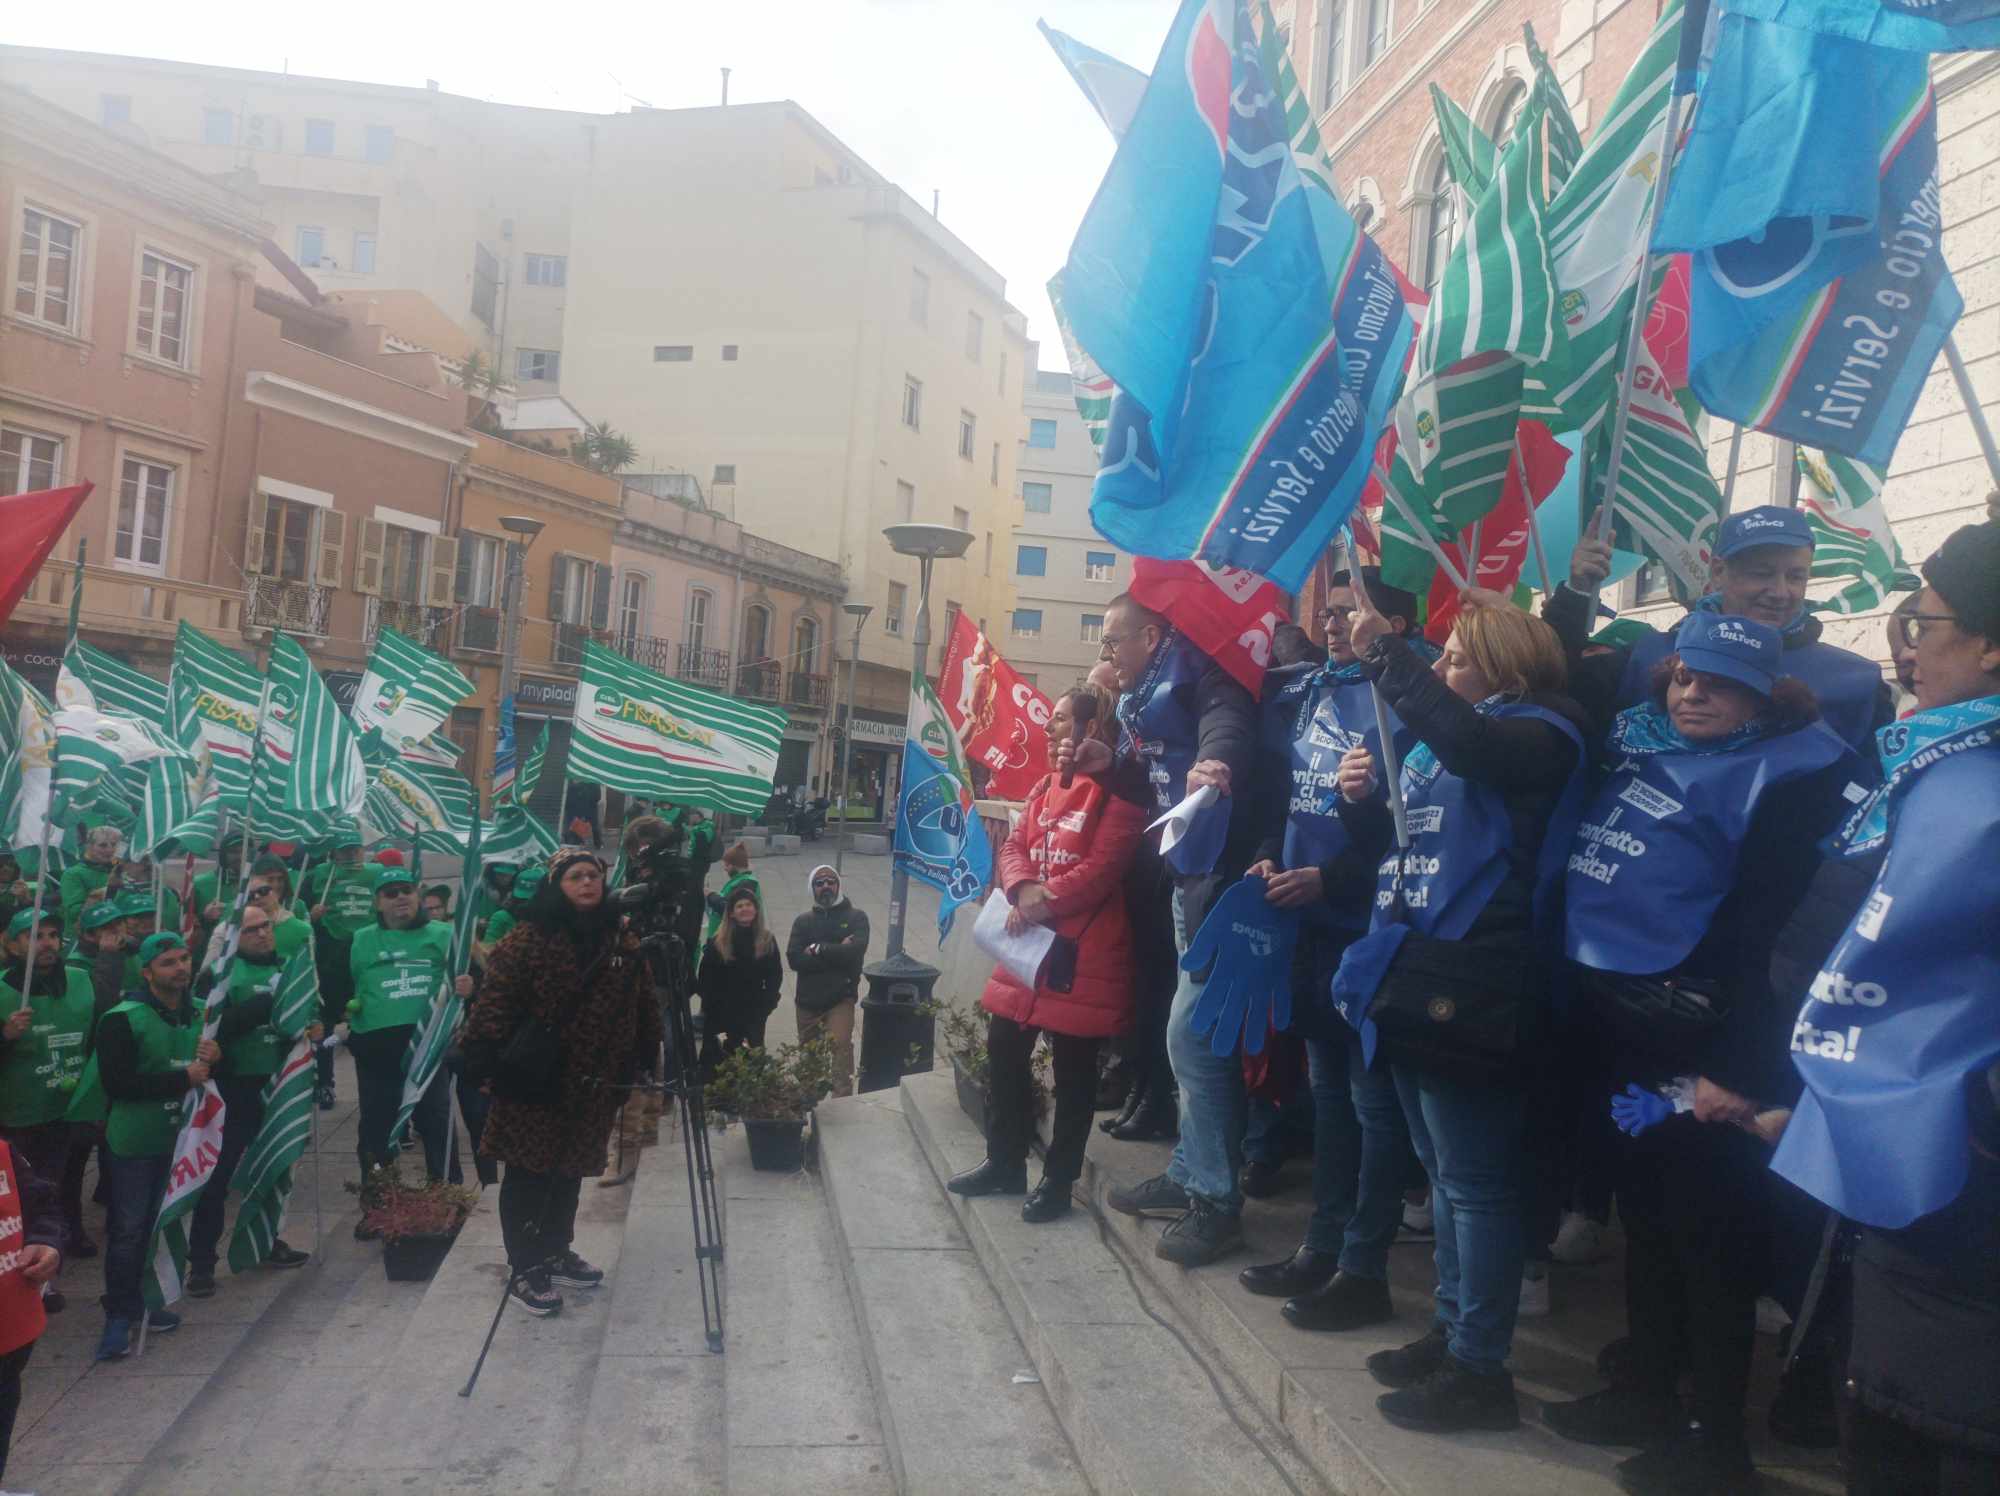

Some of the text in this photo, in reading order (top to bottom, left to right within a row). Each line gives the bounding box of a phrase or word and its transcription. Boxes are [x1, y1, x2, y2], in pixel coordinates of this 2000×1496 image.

[1719, 630, 1763, 649] UILTuCS
[623, 699, 716, 746] FISASCAT
[1012, 683, 1050, 725] CG
